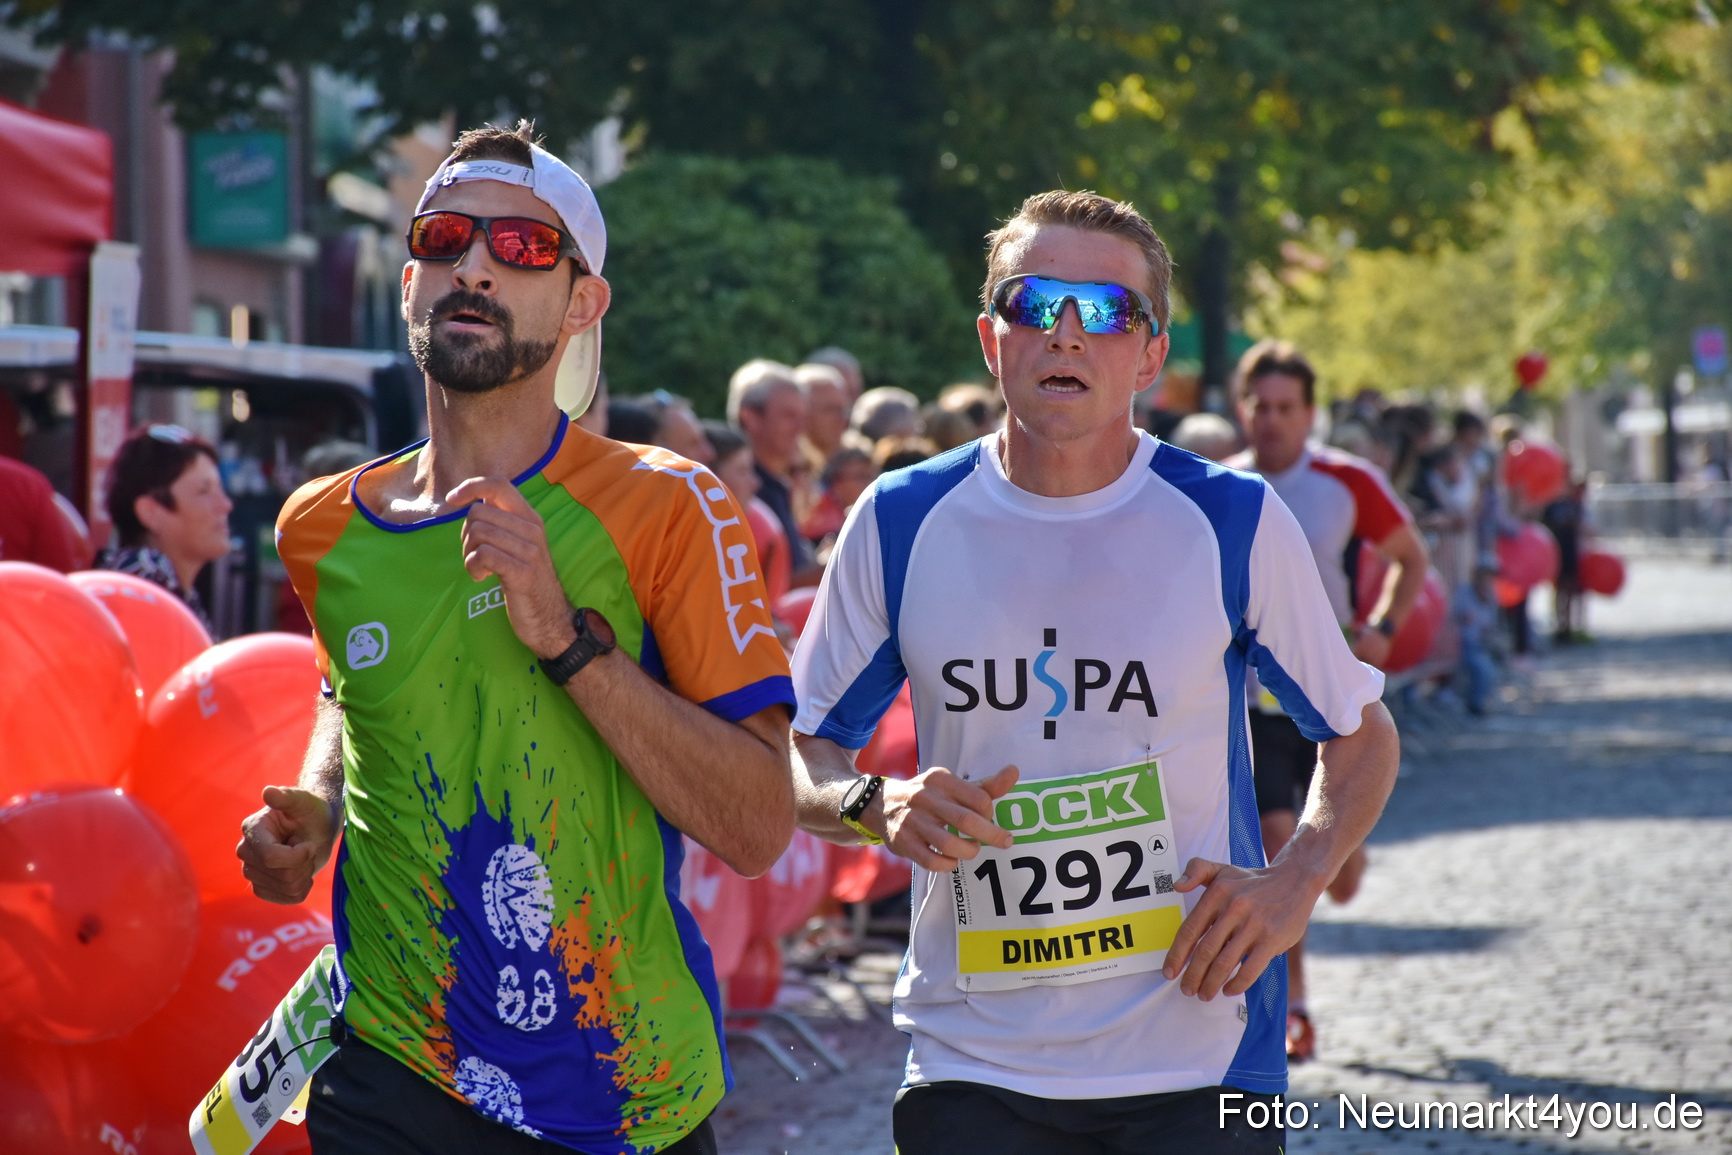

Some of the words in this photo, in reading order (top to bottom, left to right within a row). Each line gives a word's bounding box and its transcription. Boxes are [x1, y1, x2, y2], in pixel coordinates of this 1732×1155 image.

[467, 165, 512, 176] 2XU
[468, 585, 506, 619] BO
[941, 649, 1158, 718] SUSPA
[989, 773, 1149, 836] OCK
[1153, 839, 1164, 851] A
[974, 840, 1150, 916] 1292
[1002, 924, 1134, 965] DIMITRI
[205, 1080, 222, 1125] EL
[282, 1077, 291, 1091] C
